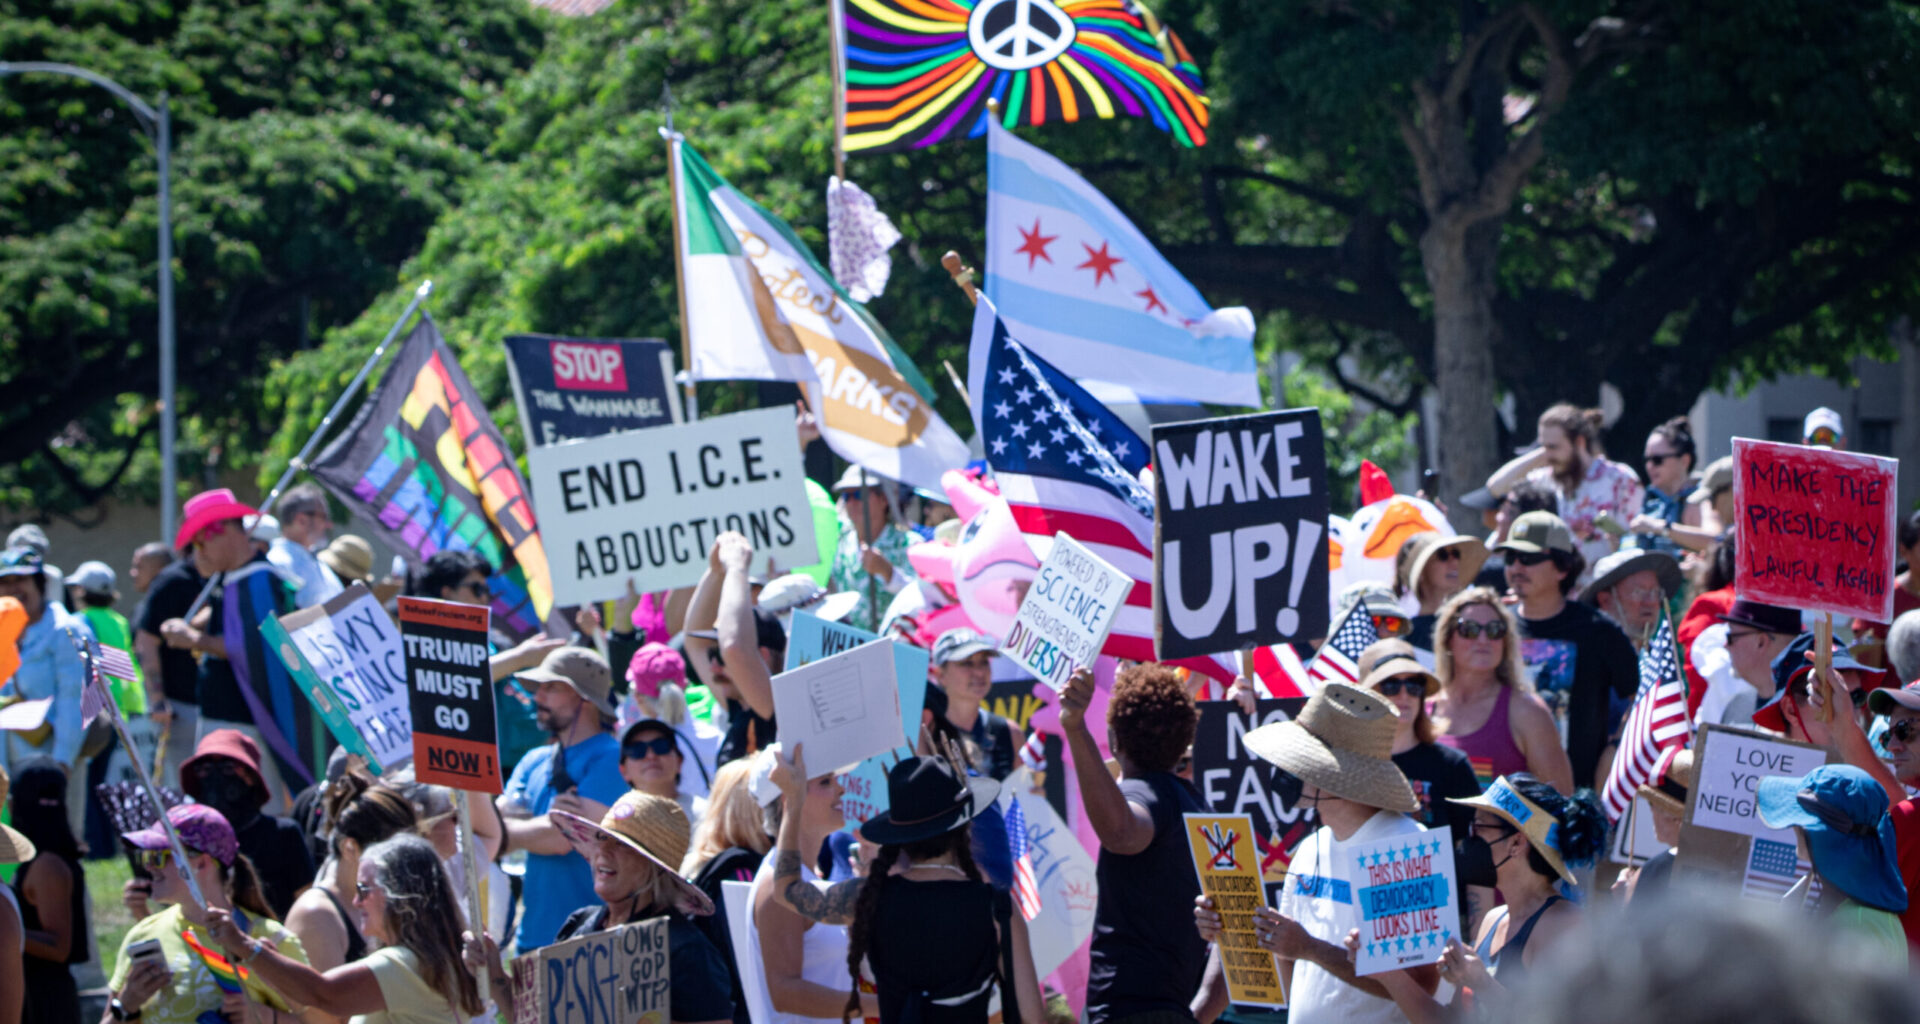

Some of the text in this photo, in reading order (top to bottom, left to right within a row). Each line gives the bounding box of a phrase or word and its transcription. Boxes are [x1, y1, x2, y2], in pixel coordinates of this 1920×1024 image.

[554, 343, 620, 383] STOP
[531, 389, 565, 411] THE
[559, 438, 781, 513] END I.C.E.
[1157, 420, 1311, 511] WAKE
[1751, 461, 1882, 506] MAKE THE
[1748, 505, 1879, 556] PRESIDENCY
[1054, 543, 1111, 596] POWERED BY
[1163, 518, 1323, 639] UP!
[1751, 550, 1885, 596] LAWFUL AGAIN
[1037, 568, 1106, 633] SCIENCE
[308, 607, 386, 669] IS MY
[404, 634, 486, 667] TRUMP
[1007, 620, 1079, 683] DIVERSITY
[1078, 640, 1096, 663] BY
[415, 668, 482, 700] MUST
[435, 705, 469, 731] GO
[1736, 747, 1794, 773] LOVE
[1215, 876, 1257, 892] DICTATORS
[1368, 855, 1432, 887] THIS IS WHAT
[1371, 880, 1434, 914] DEMOCRACY
[624, 921, 664, 955] OMG
[1372, 907, 1439, 940] LOOKS LIKE
[631, 952, 664, 983] GOP
